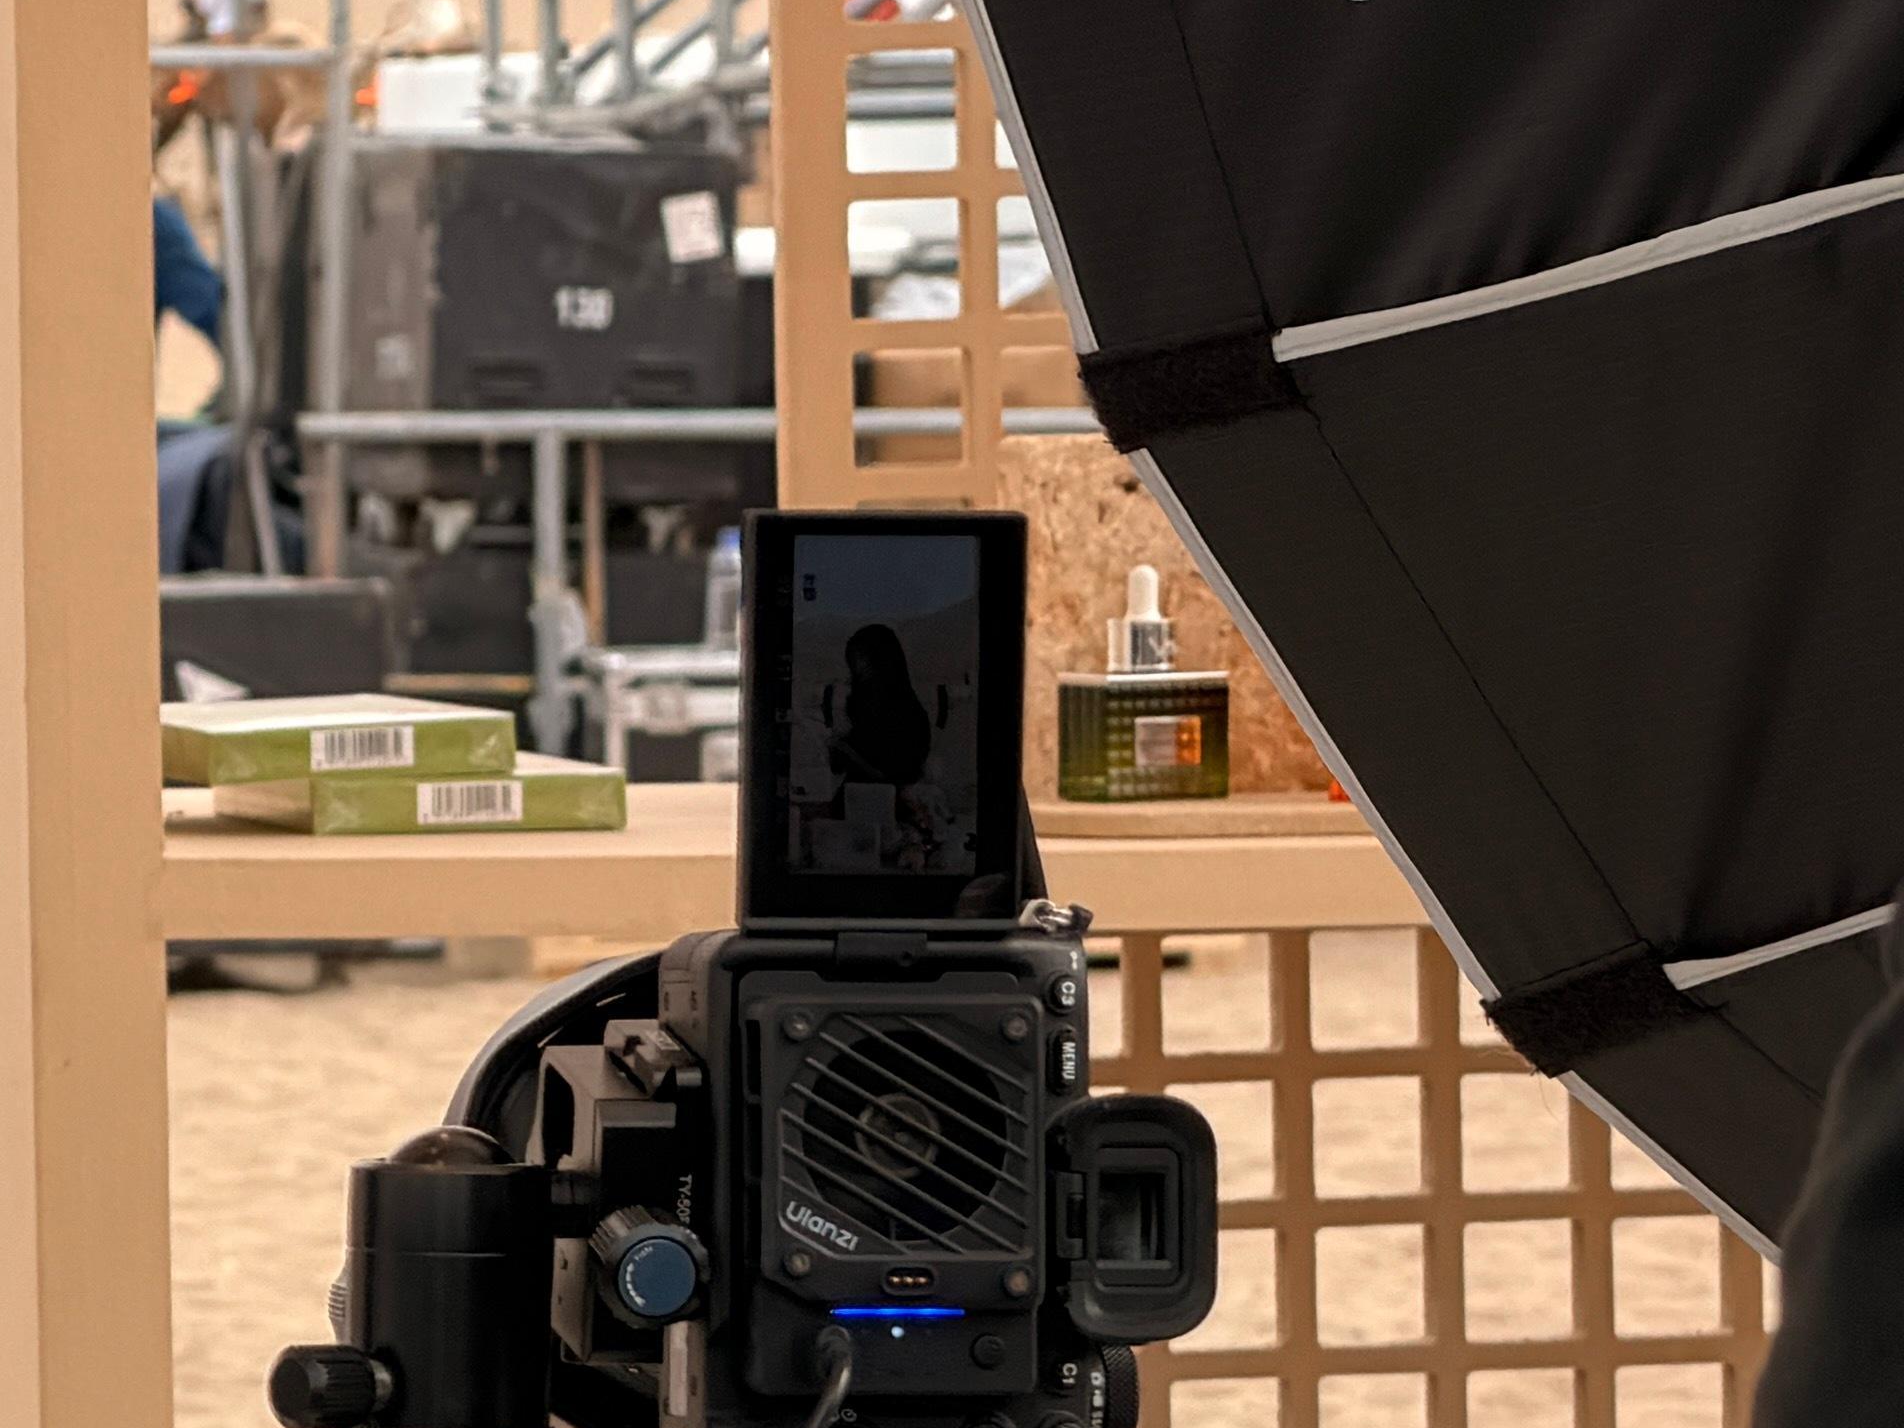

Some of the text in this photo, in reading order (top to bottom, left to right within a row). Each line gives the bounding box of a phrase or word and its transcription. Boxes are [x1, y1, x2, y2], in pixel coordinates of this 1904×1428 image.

[1061, 1041, 1076, 1081] MENU
[786, 1200, 860, 1252] Ulanzi
[1061, 1362, 1078, 1385] C1
